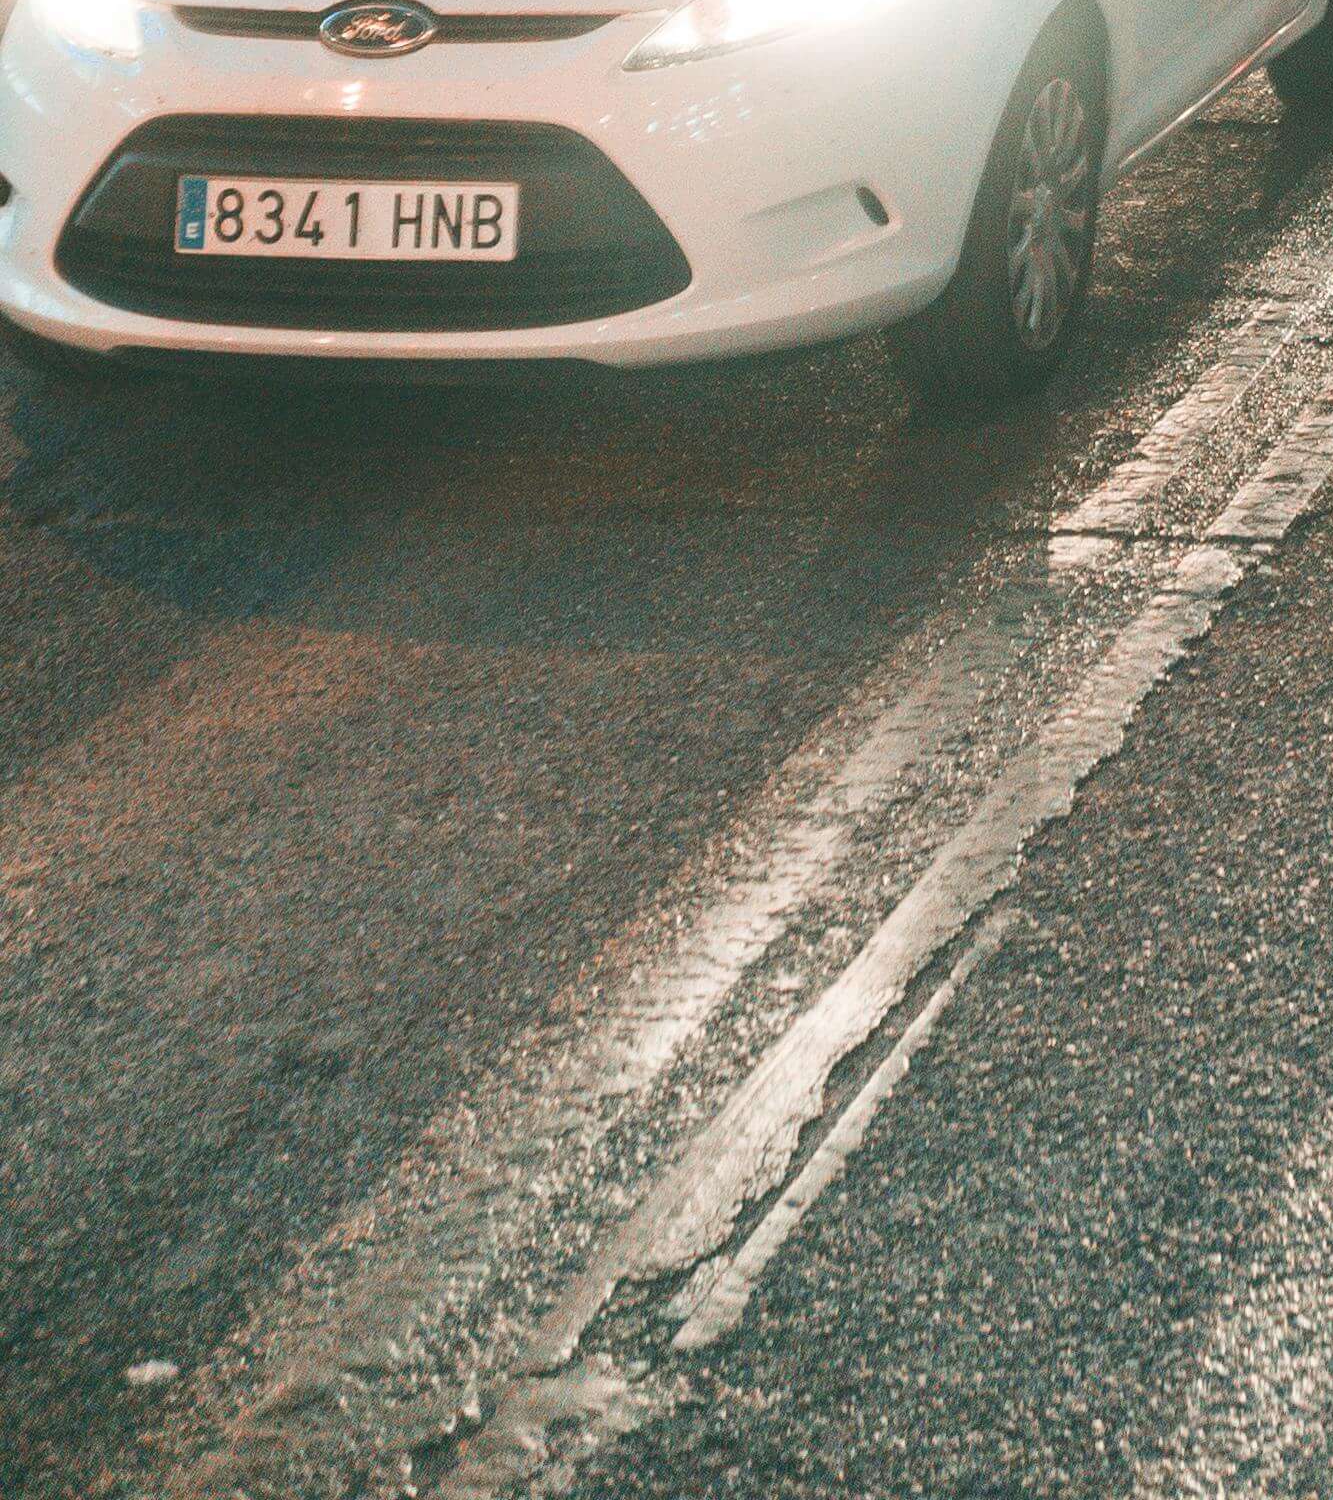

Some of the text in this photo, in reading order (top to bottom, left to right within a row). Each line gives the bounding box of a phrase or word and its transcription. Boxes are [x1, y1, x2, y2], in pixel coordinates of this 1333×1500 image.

[341, 11, 407, 43] Ford
[213, 187, 504, 251] 8341 HNB
